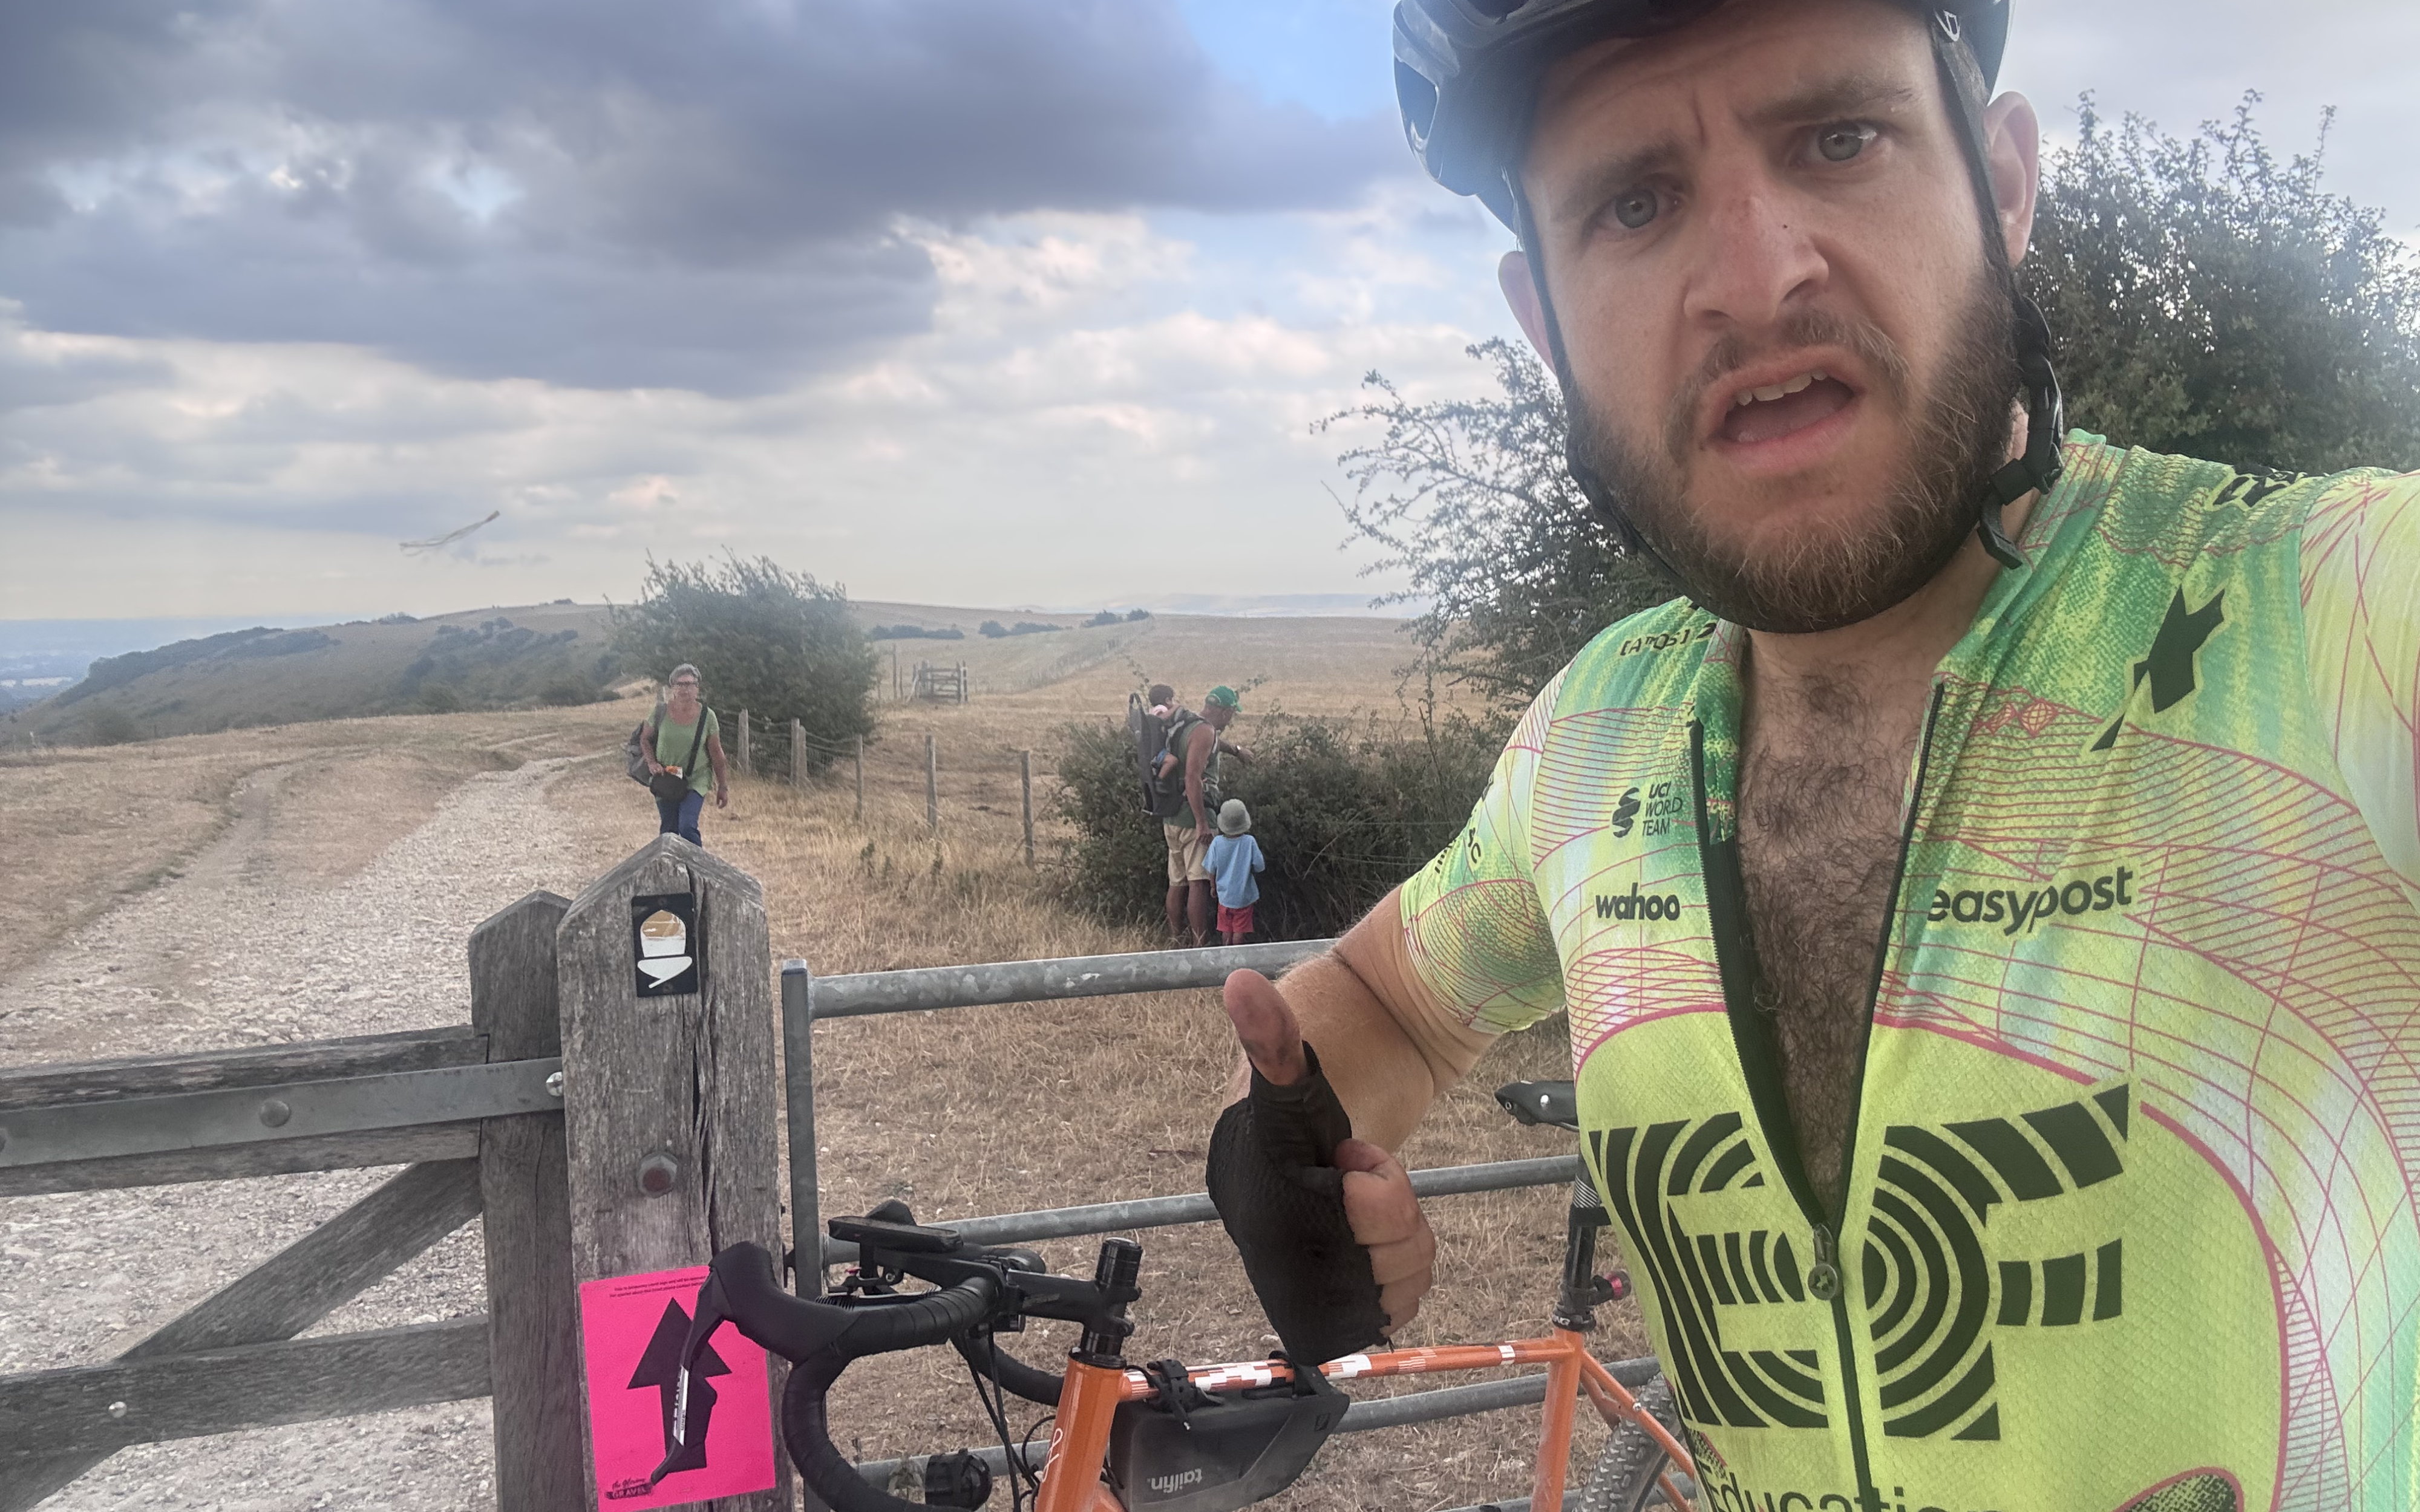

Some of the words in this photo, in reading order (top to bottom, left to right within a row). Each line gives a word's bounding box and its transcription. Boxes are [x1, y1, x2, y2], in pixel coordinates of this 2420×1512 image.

[1649, 781, 1671, 799] UCI
[1642, 817, 1670, 836] TEAM
[1595, 882, 1681, 921] wahoo
[1926, 865, 2133, 936] easypost
